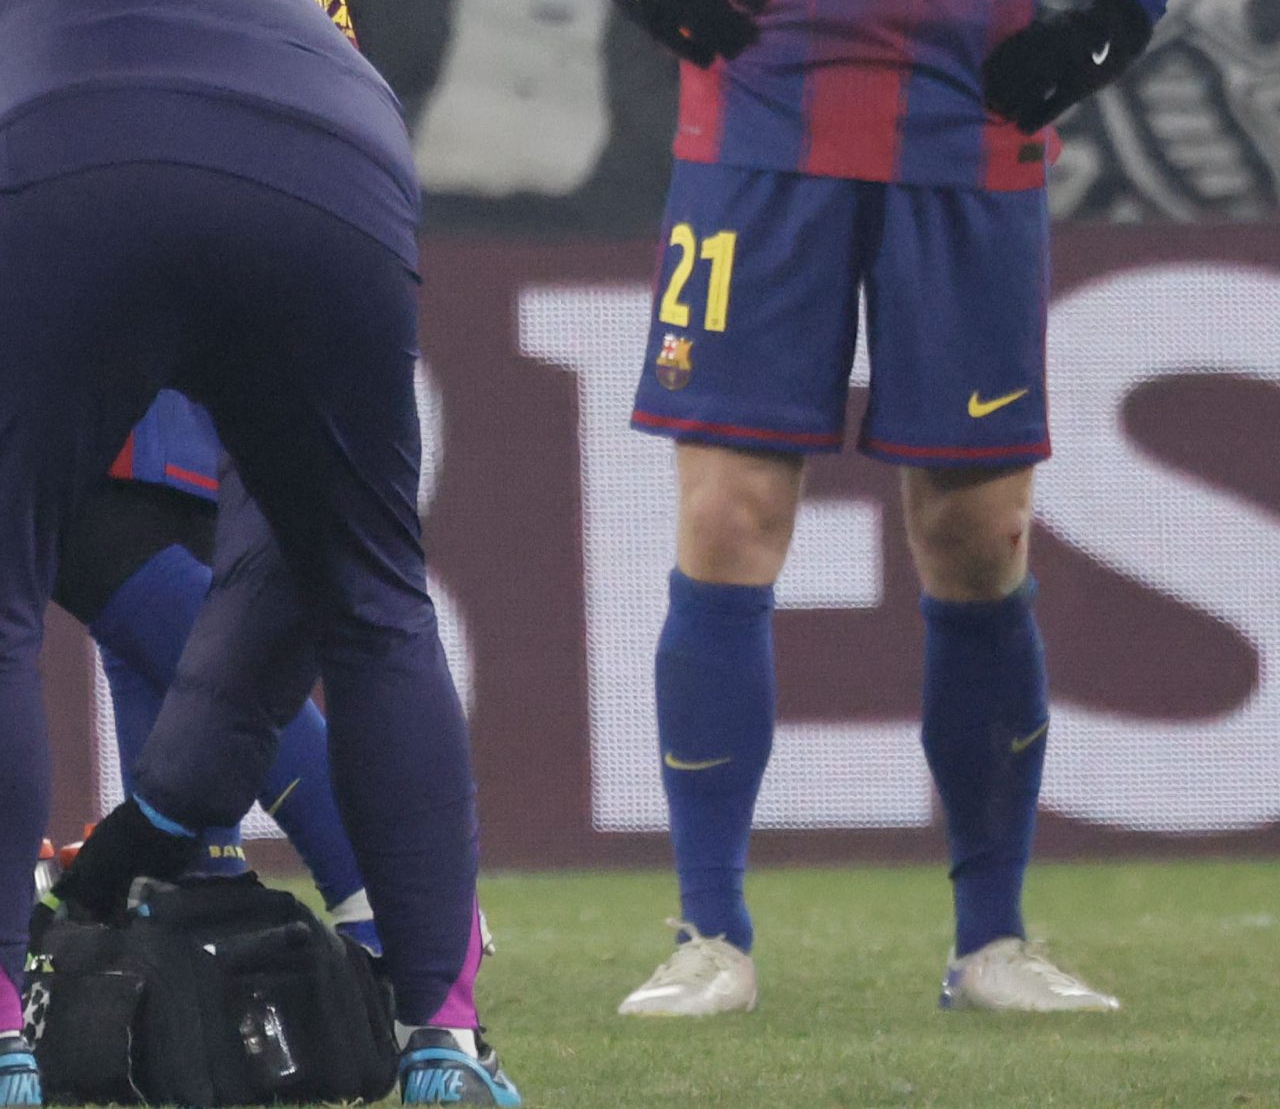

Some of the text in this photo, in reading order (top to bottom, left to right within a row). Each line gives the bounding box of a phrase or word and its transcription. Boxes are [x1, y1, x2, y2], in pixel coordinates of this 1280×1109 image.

[658, 222, 738, 332] 21
[92, 258, 1280, 837] ES
[404, 1068, 464, 1104] NIKE
